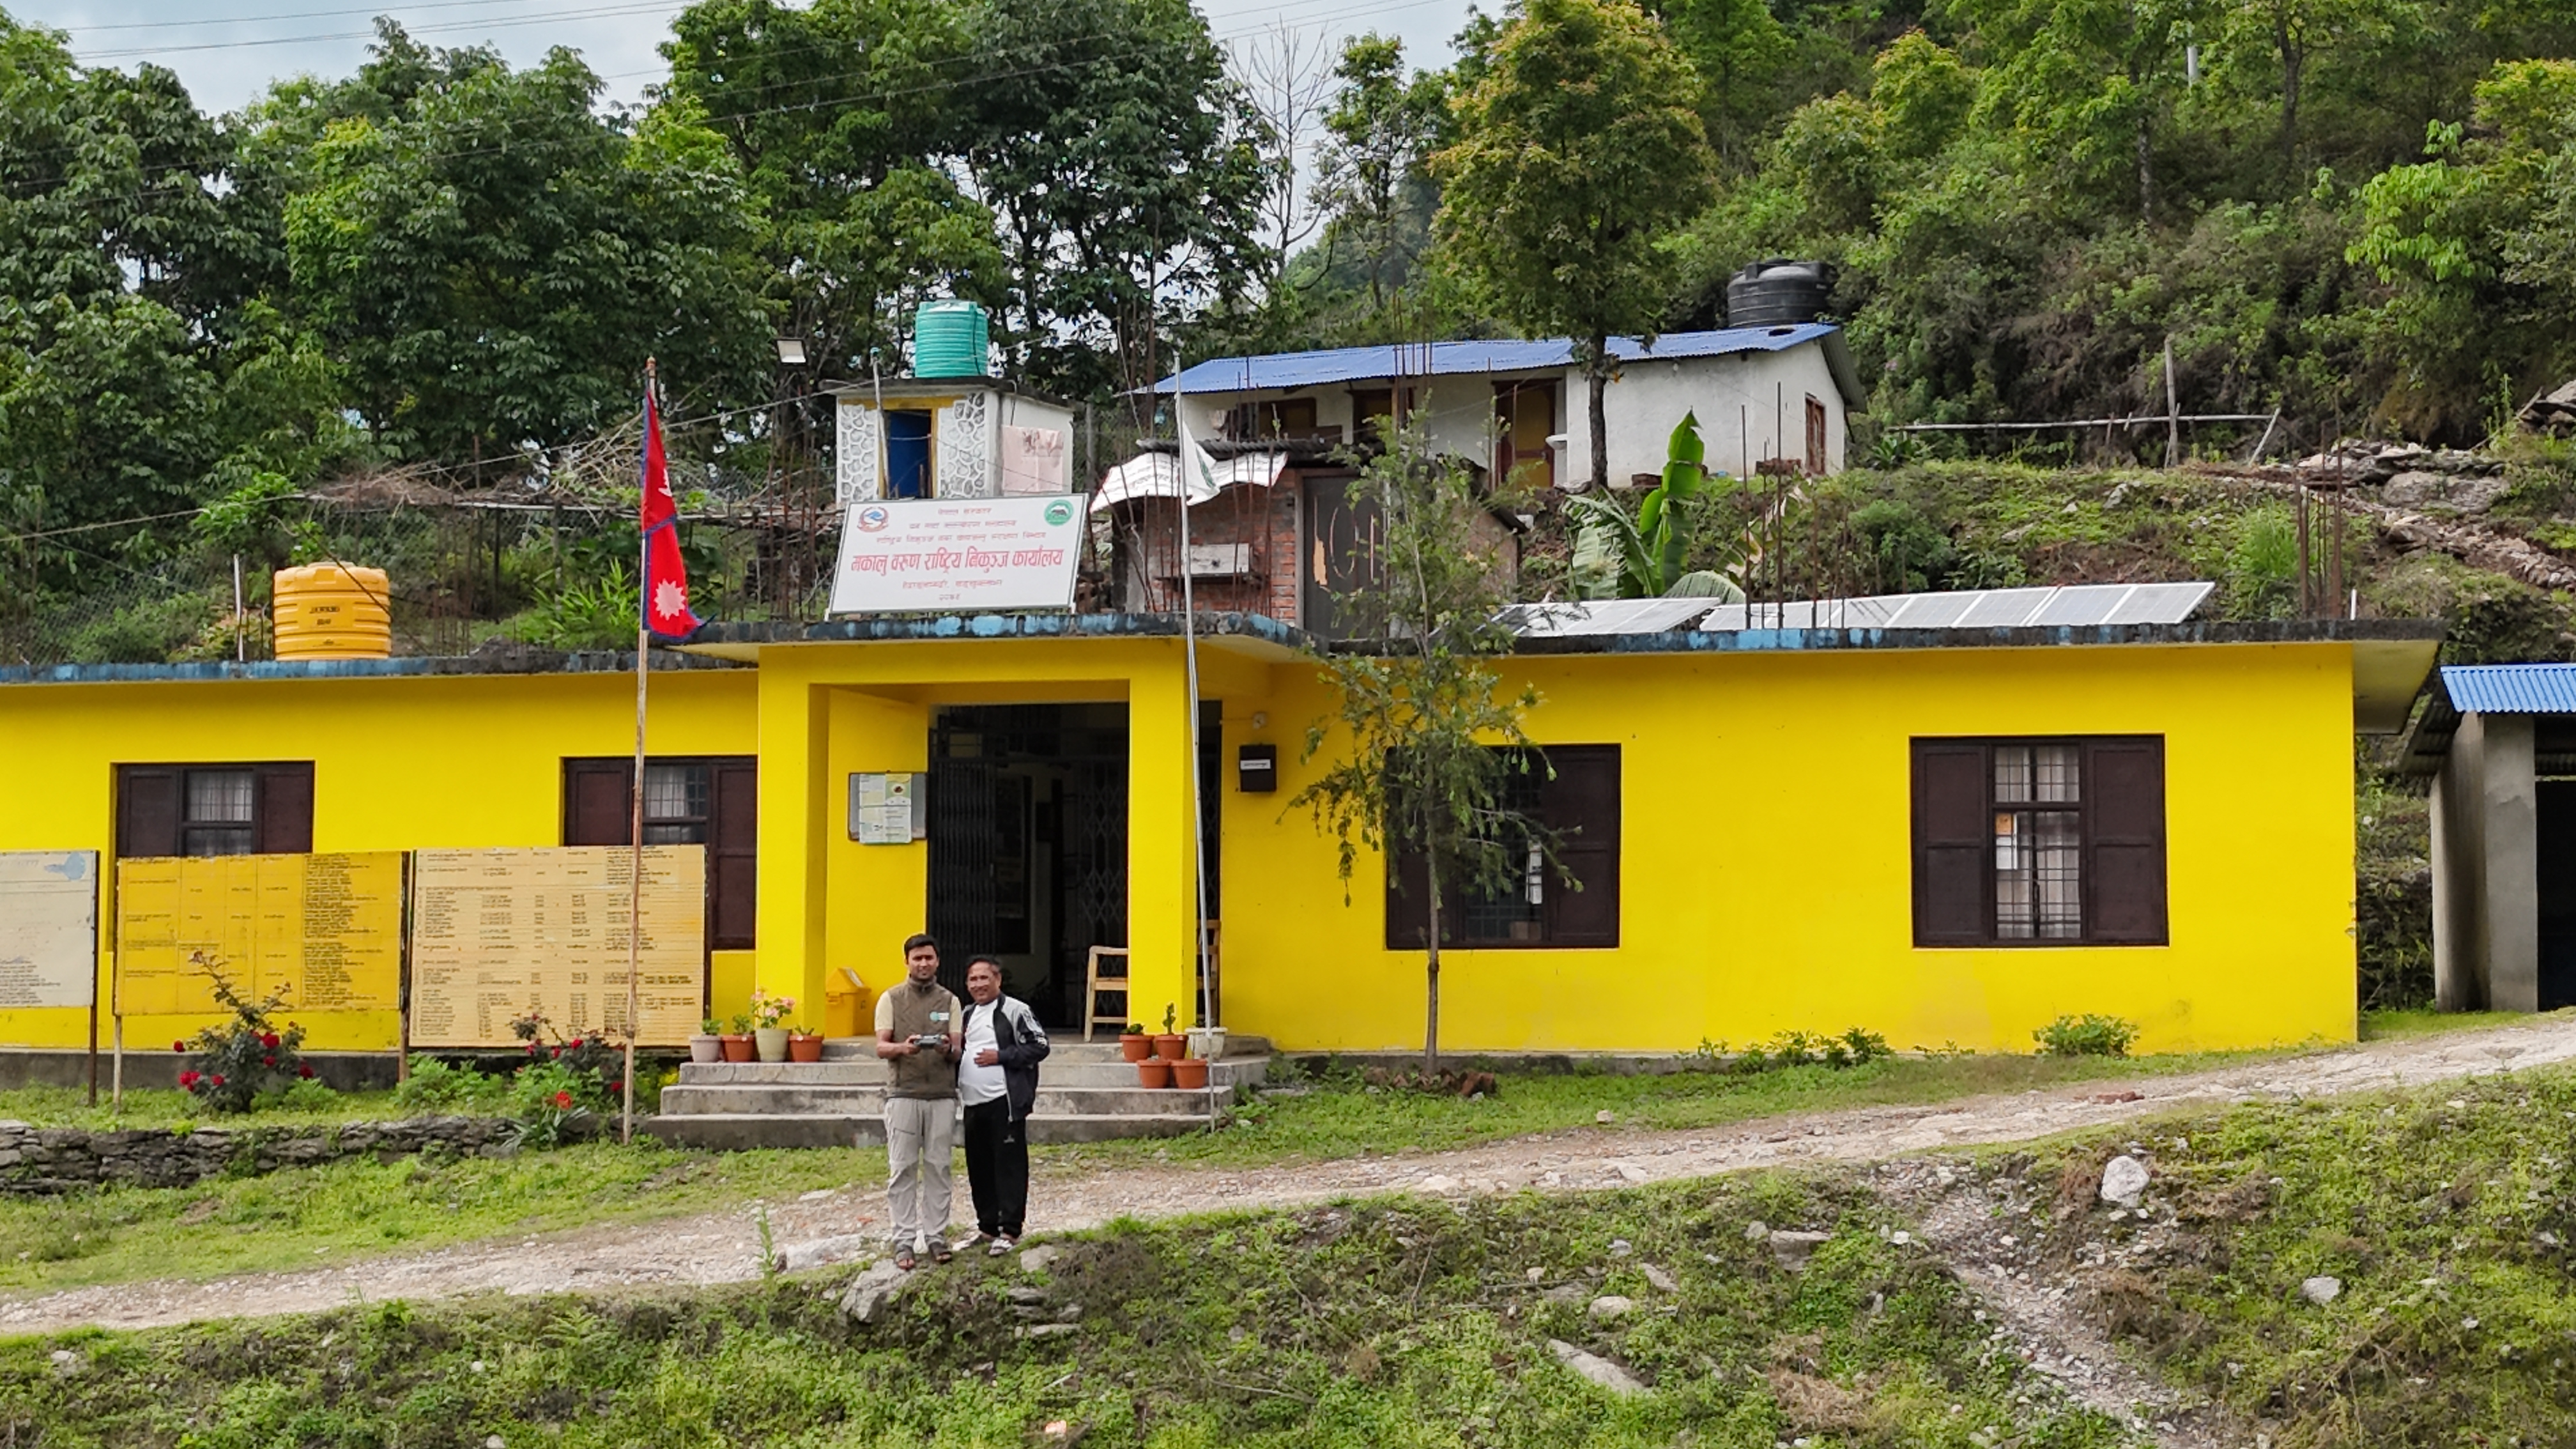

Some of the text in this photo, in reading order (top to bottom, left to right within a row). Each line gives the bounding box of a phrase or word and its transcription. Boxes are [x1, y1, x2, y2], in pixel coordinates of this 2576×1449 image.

[851, 555, 889, 576] मकालु
[924, 547, 962, 574] राष्ट्रिय
[965, 546, 1010, 573] निकुञ्ज
[1012, 544, 1064, 566] कार्यालय
